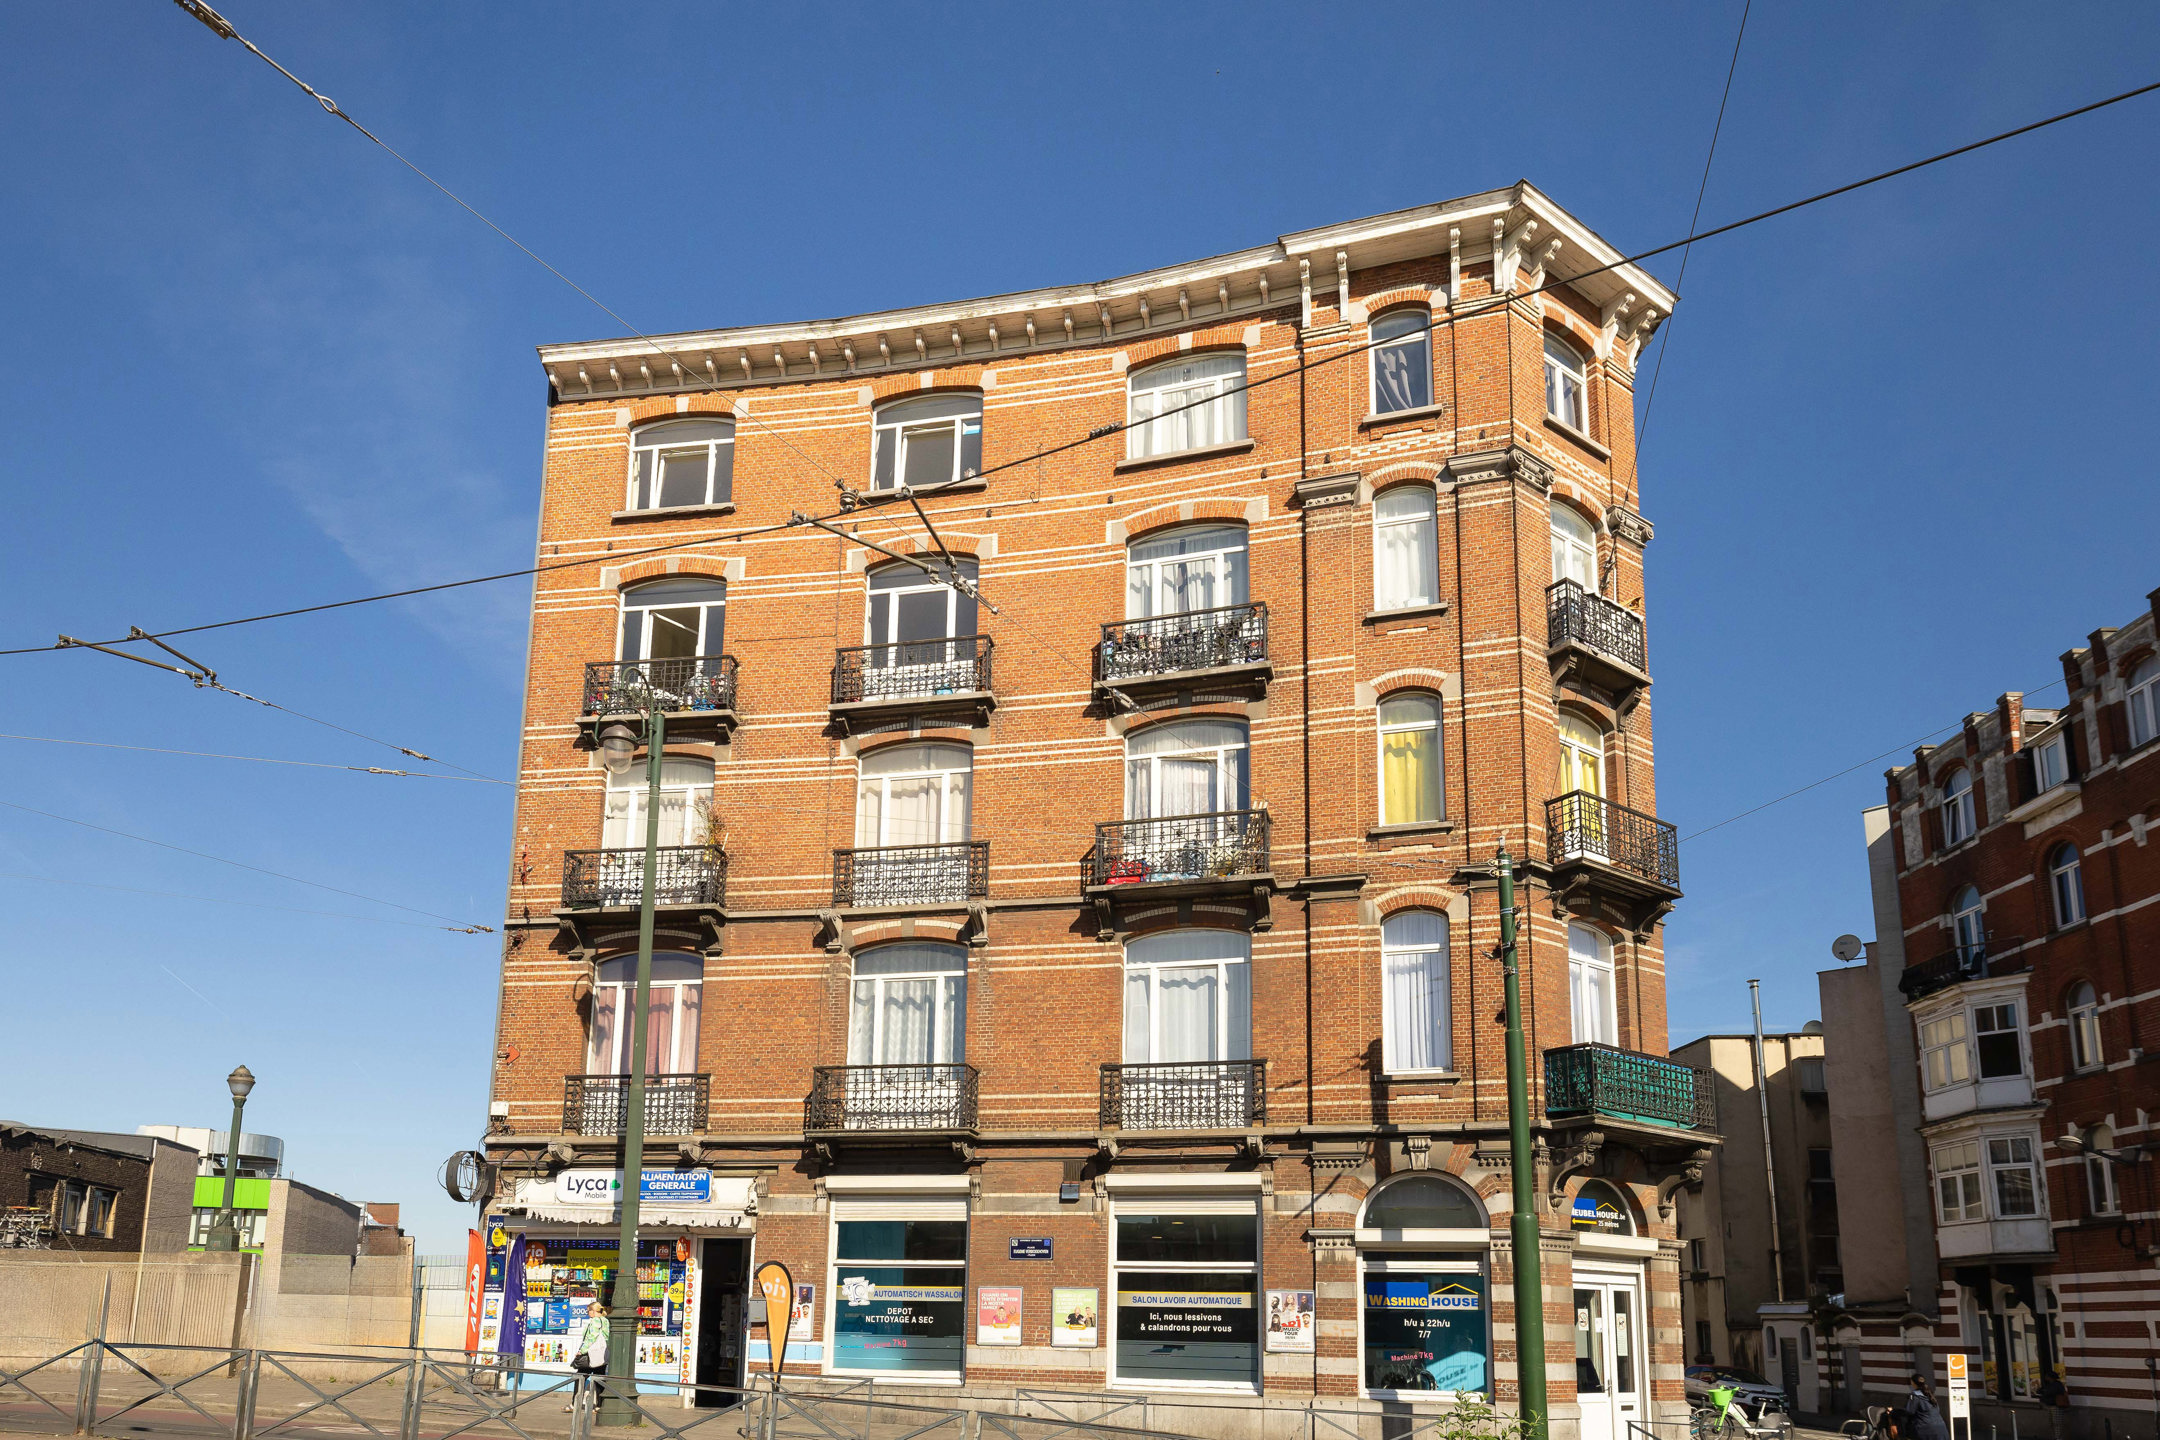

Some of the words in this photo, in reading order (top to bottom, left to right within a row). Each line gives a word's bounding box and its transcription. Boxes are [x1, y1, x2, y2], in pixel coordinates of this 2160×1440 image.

[640, 1172, 707, 1181] ALIMENTATION
[567, 1176, 607, 1194] Lyca
[648, 1181, 696, 1190] GENERALE
[525, 1244, 544, 1258] ria
[658, 1246, 669, 1254] ria
[873, 1290, 922, 1298] AUTOMATISCH
[924, 1290, 964, 1299] WASSALON
[1132, 1295, 1158, 1304] SALON
[1159, 1296, 1187, 1305] LAVOIR
[1187, 1296, 1242, 1305] AUTOMATIQUE
[1368, 1294, 1428, 1307] WASHING
[1431, 1297, 1479, 1307] HOUSE
[887, 1307, 912, 1315] DEPOT
[918, 1316, 934, 1324] SEC
[1149, 1312, 1162, 1322] Ici,
[1163, 1313, 1183, 1321] nous
[1184, 1313, 1222, 1322] lessivons
[1403, 1318, 1417, 1327] h/u
[1426, 1319, 1451, 1328] 22h/u
[1140, 1323, 1146, 1331] &
[1147, 1323, 1191, 1332] calandrons
[1192, 1324, 1211, 1334] pour
[1212, 1325, 1232, 1333] vous
[1418, 1330, 1431, 1338] 7/7
[892, 1338, 907, 1348] 7kg
[1390, 1352, 1418, 1361] Machine
[1418, 1351, 1434, 1360] 7kg
